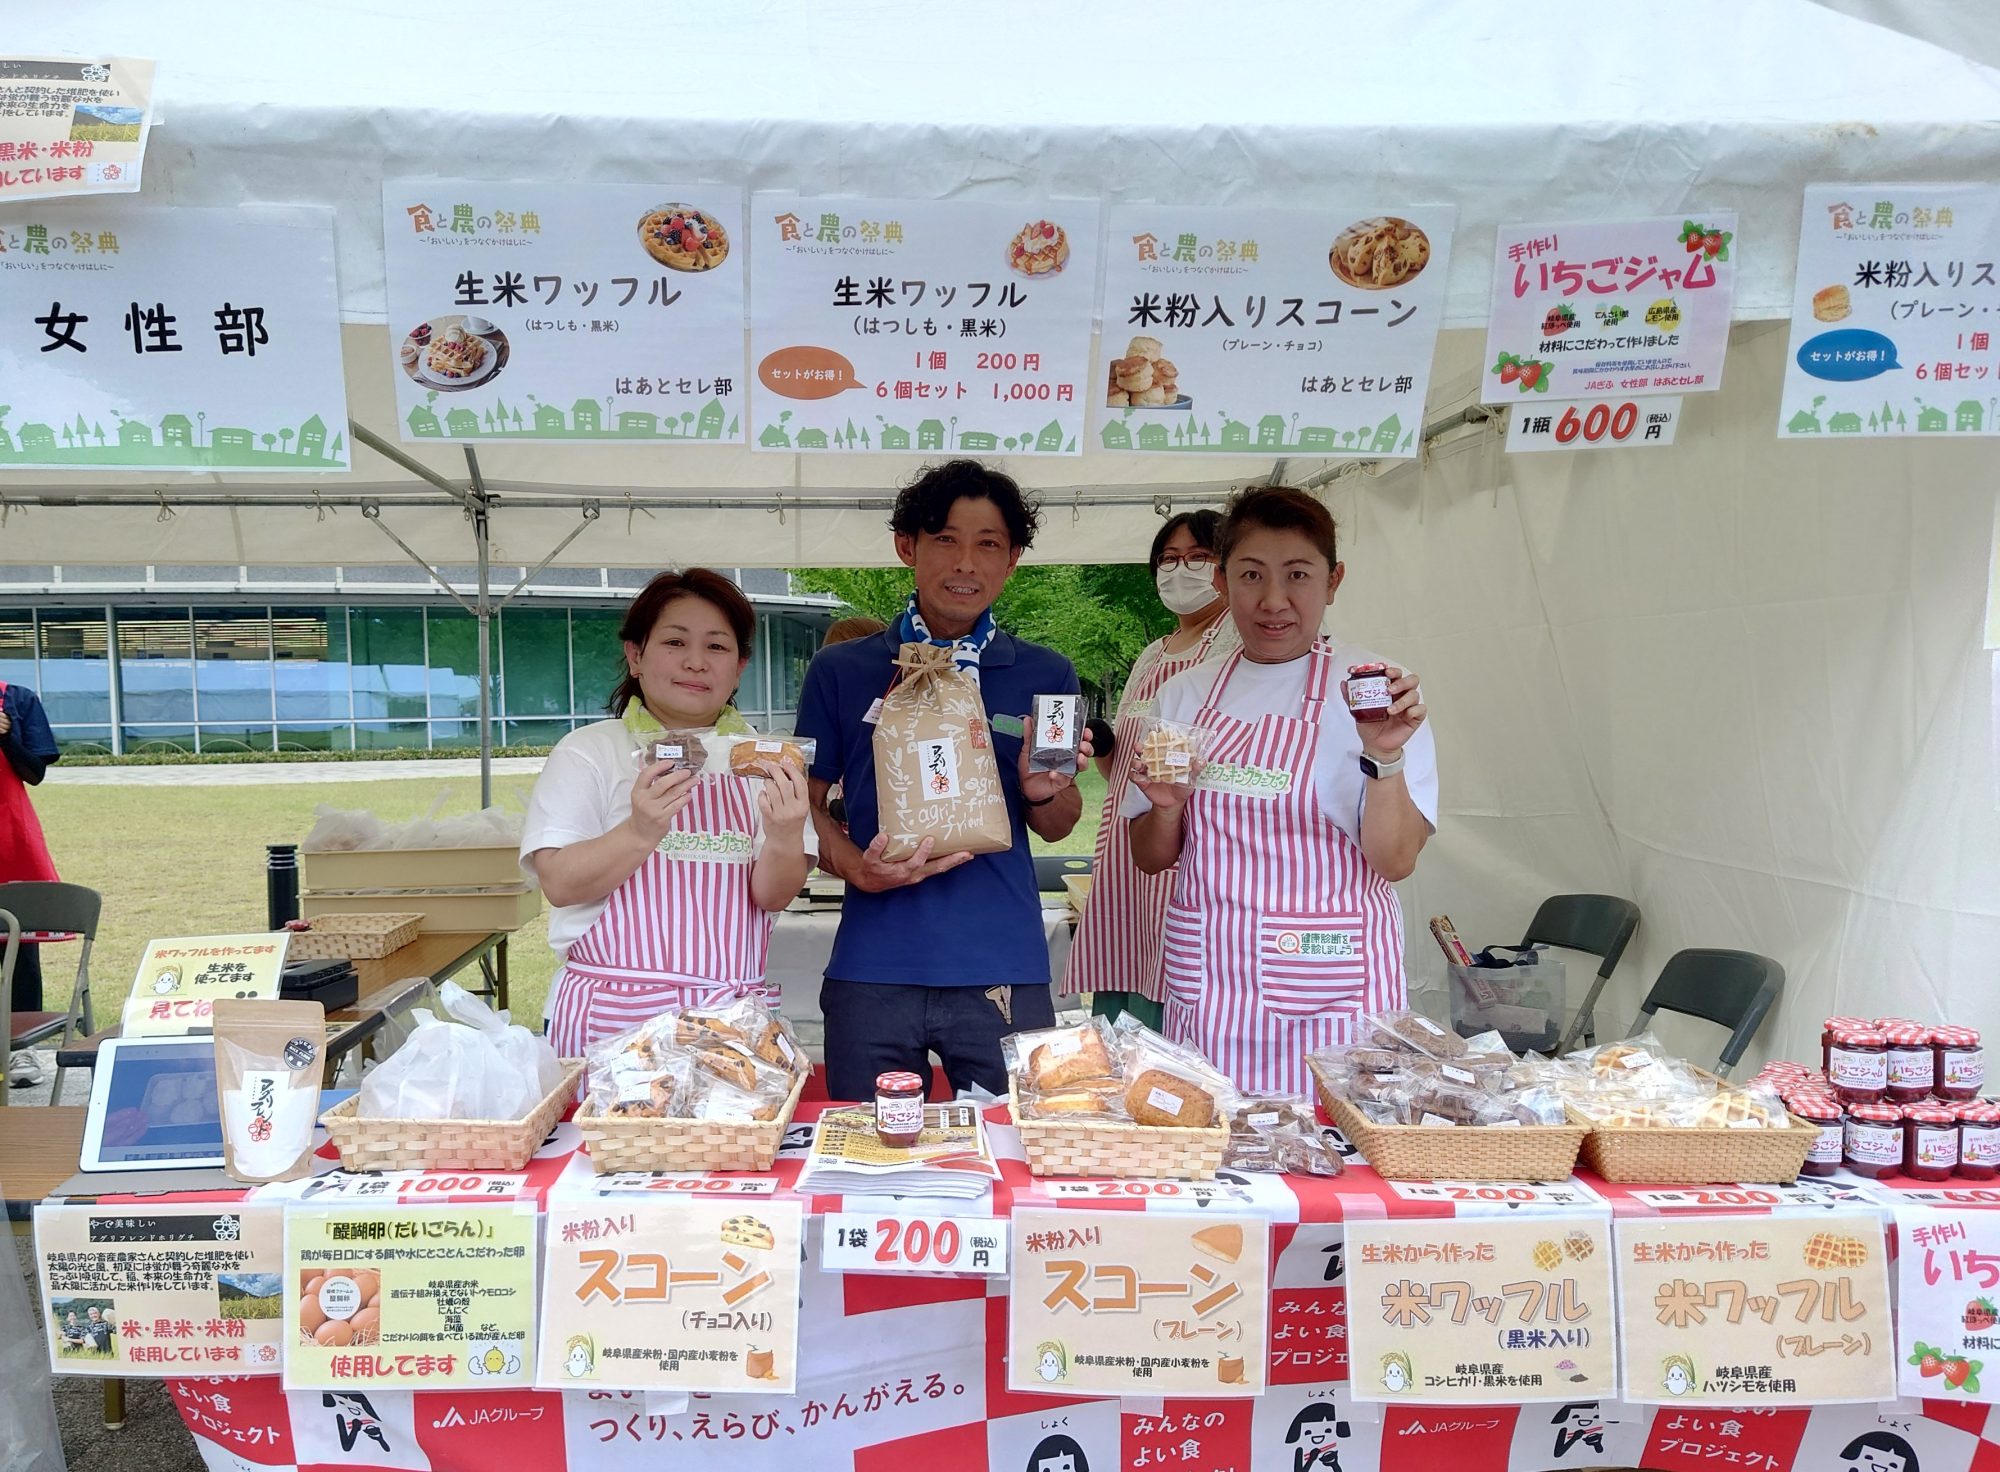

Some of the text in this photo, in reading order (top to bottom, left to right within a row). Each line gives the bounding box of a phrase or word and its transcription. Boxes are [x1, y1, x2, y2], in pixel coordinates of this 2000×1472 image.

[0, 165, 85, 188] しています
[407, 203, 541, 235] 食と農の祭典
[1827, 201, 1954, 231] 食と農の祭典
[0, 224, 120, 254] と農の祭典
[775, 212, 904, 245] 食と農の祭典
[1133, 232, 1260, 264] 食と農の祭典
[1508, 234, 1558, 262] 手作り
[1514, 254, 1717, 298] いちごジャム
[1853, 260, 1997, 289] 米粉入りス
[454, 270, 682, 308] 生米ワッフル
[833, 275, 1028, 309] 生米ワッフル
[1128, 292, 1418, 328] 米粉入りスコーン
[1539, 334, 1680, 354] 材料にこだわって作りました
[915, 351, 1040, 372] 1個 200円
[615, 376, 733, 398] はあとセレ部
[876, 380, 1075, 402] 6個セット 1,000円
[1301, 374, 1413, 394] はあとセレ部
[1522, 415, 1552, 434] 1瓶
[1555, 402, 1640, 443] 600
[1645, 424, 1661, 440] 円
[154, 945, 277, 959] 米ワッフルを作ってます
[194, 972, 256, 985] 使ってます
[207, 963, 247, 974] 生米を
[397, 1177, 483, 1193] 1000
[646, 1179, 732, 1191] 200
[1095, 1183, 1180, 1195] 200
[1444, 1187, 1536, 1200] 200
[1683, 1191, 1779, 1205] 200
[562, 1214, 636, 1242] 米粉入り
[1026, 1226, 1101, 1252] 米粉入り
[1912, 1221, 1966, 1247] 手作り
[838, 1228, 868, 1247] 1袋
[874, 1218, 960, 1265] 200
[1633, 1241, 1770, 1263] 生米から作った
[972, 1250, 990, 1267] 円
[1362, 1243, 1495, 1264] 生米から作った
[428, 1280, 479, 1289] 岐阜県産お米
[575, 1248, 771, 1306] スコーン
[1042, 1260, 1240, 1317] スコーン
[438, 1306, 468, 1315] にんにく
[1381, 1279, 1590, 1326] 米ワッフル
[1655, 1277, 1866, 1327] 米ワッフル
[121, 1318, 246, 1338] 米・黒米・米粉
[129, 1346, 241, 1362] 使用しています
[602, 1347, 738, 1361] 岐阜県産米粉・国内産小麦粉を
[1075, 1354, 1210, 1369] 岐阜県産米粉・国内産小麦粉を
[330, 1354, 457, 1378] 使用してます
[659, 1360, 679, 1371] 使用
[1133, 1368, 1152, 1378] 使用
[1455, 1364, 1504, 1376] 岐阜県産
[1715, 1366, 1773, 1379] 岐阜県産
[1425, 1374, 1543, 1388] コシヒカリ・黒米を使用
[1702, 1379, 1797, 1393] ハツシモを使用
[177, 1381, 232, 1414] よい食
[1308, 1388, 1335, 1397] しょく
[469, 1405, 545, 1425] JAグループ
[589, 1372, 965, 1443] つくり、えらび、かんがえる。
[185, 1406, 280, 1445] プロジェクト
[1041, 1416, 1068, 1430] しょく
[1133, 1412, 1226, 1436] みんなの
[1430, 1419, 1500, 1434] JAグループ
[1666, 1415, 1744, 1438] よい食
[1877, 1414, 1912, 1432] しょく
[1133, 1438, 1201, 1467] よい食
[1660, 1438, 1780, 1471] プロジェクト
